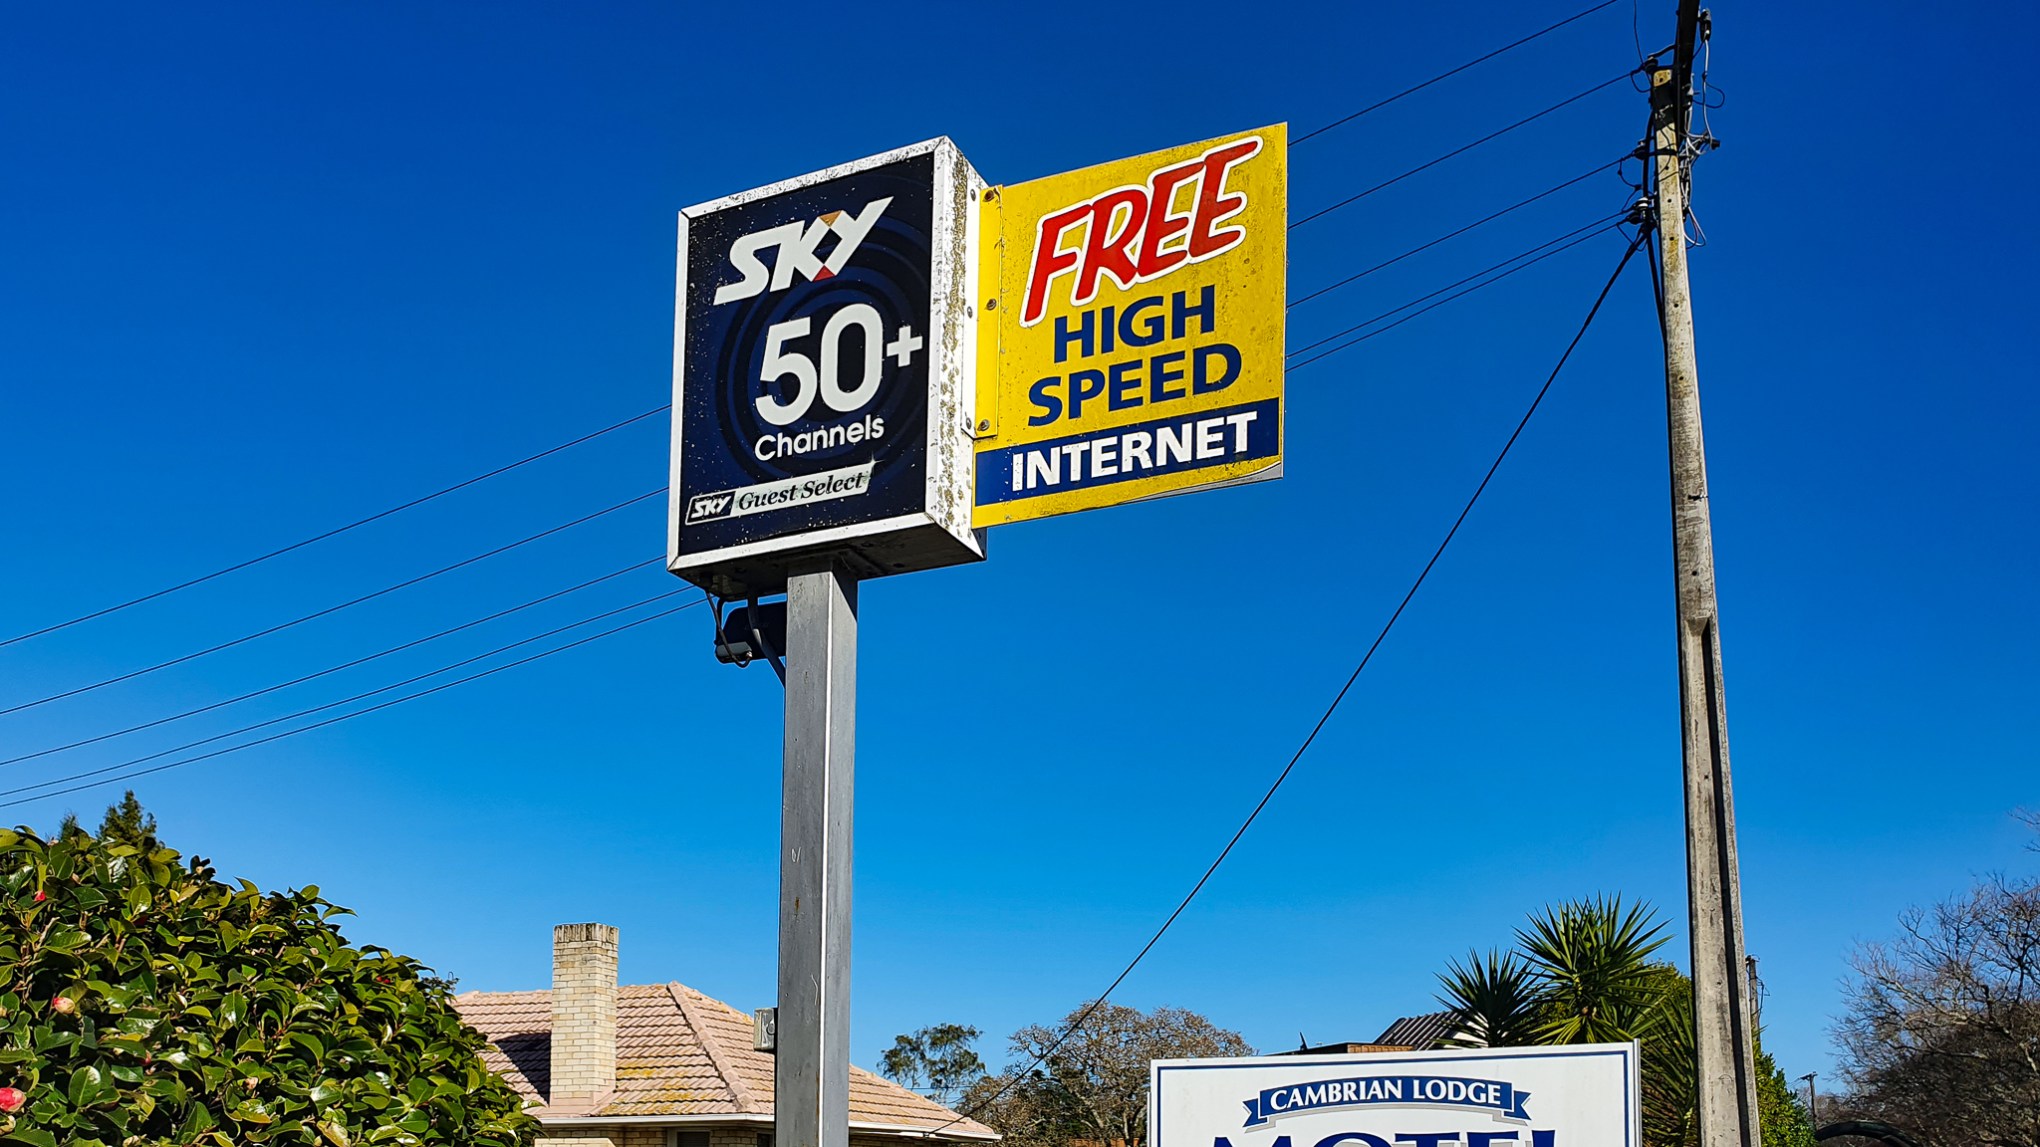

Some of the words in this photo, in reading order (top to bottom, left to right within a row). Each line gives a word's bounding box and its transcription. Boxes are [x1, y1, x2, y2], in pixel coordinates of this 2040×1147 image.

[713, 196, 894, 305] SKY
[1021, 137, 1262, 327] FREE
[1054, 285, 1215, 363] HIGH
[755, 304, 923, 426] 50+
[1028, 343, 1243, 427] SPEED
[755, 414, 885, 461] Channels
[1012, 411, 1258, 492] INTERNET
[691, 496, 732, 519] SKY
[738, 485, 799, 511] Guest
[800, 472, 863, 499] Select
[1270, 1079, 1402, 1110] CAMBRIAN
[1412, 1079, 1501, 1105] LODGE
